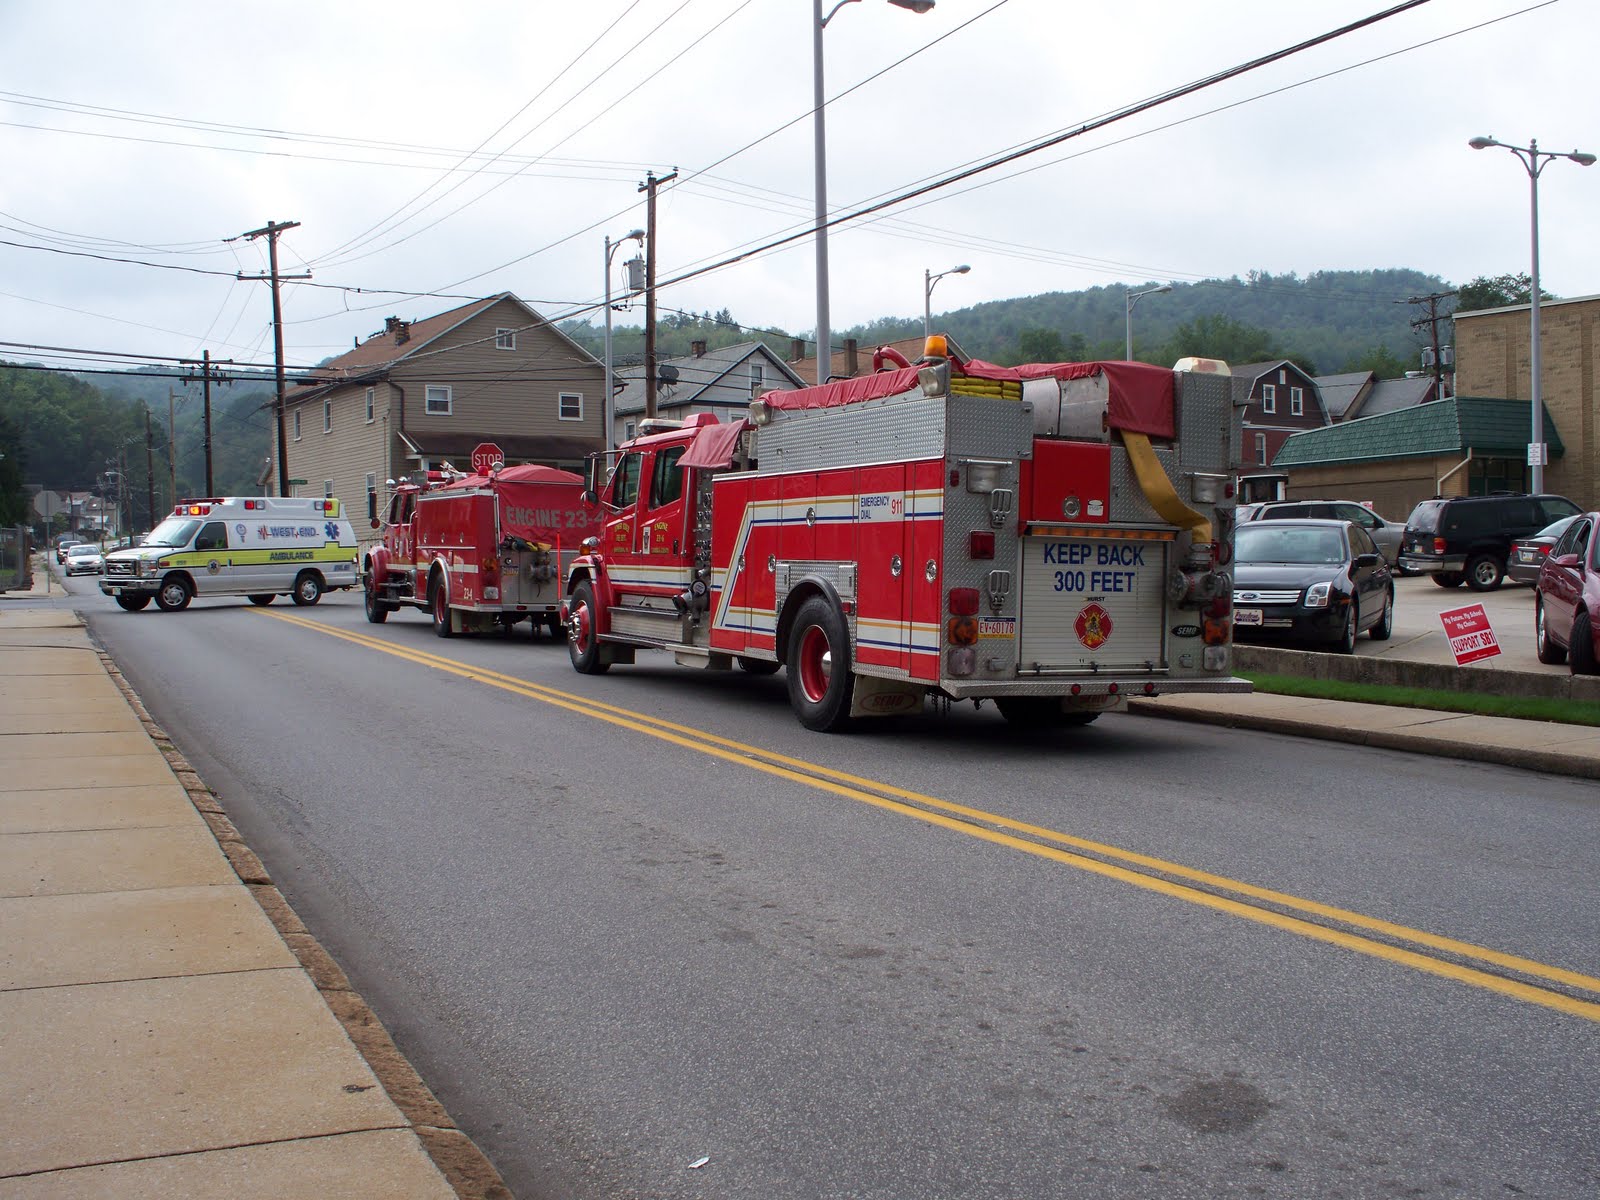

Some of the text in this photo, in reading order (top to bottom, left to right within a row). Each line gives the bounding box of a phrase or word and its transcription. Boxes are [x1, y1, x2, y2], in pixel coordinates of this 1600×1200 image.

[475, 454, 502, 466] STOP
[861, 496, 903, 515] EMERGENCY 911
[505, 506, 562, 528] ENGINE
[861, 510, 871, 519] DIAL
[270, 527, 317, 537] WEST END
[269, 551, 314, 561] AMBULANCE
[1044, 543, 1145, 566] KEEP BACK
[1054, 570, 1135, 592] 300 FEET
[1177, 626, 1197, 635] SEMO
[1453, 632, 1495, 652] SUPPORT SB1
